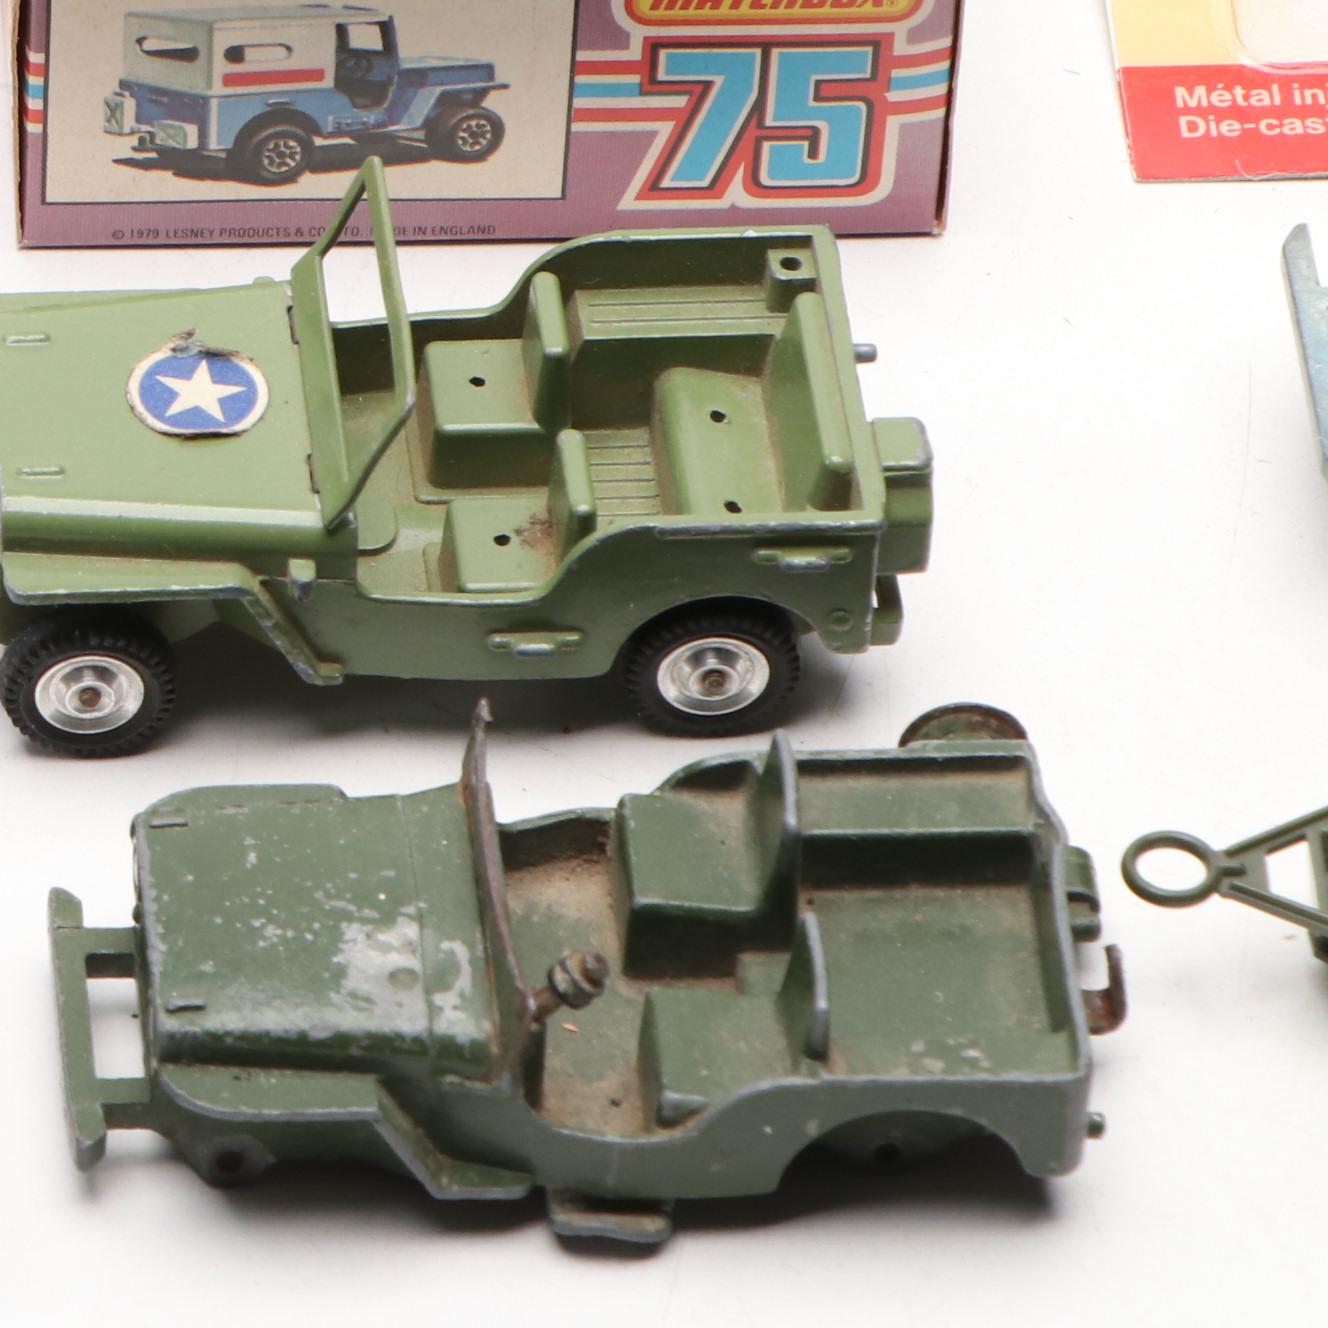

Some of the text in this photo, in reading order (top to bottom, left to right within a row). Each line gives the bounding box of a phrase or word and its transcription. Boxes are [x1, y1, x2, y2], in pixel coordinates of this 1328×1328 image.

[1174, 83, 1328, 109] Métal in
[644, 38, 885, 192] 75
[1178, 114, 1328, 139] Die-cas
[129, 228, 160, 240] 1979
[166, 227, 216, 240] LESNEY
[219, 226, 291, 239] PRODUCTS
[294, 226, 305, 239] &
[413, 226, 429, 237] IN
[432, 224, 497, 237] ENGLAND
